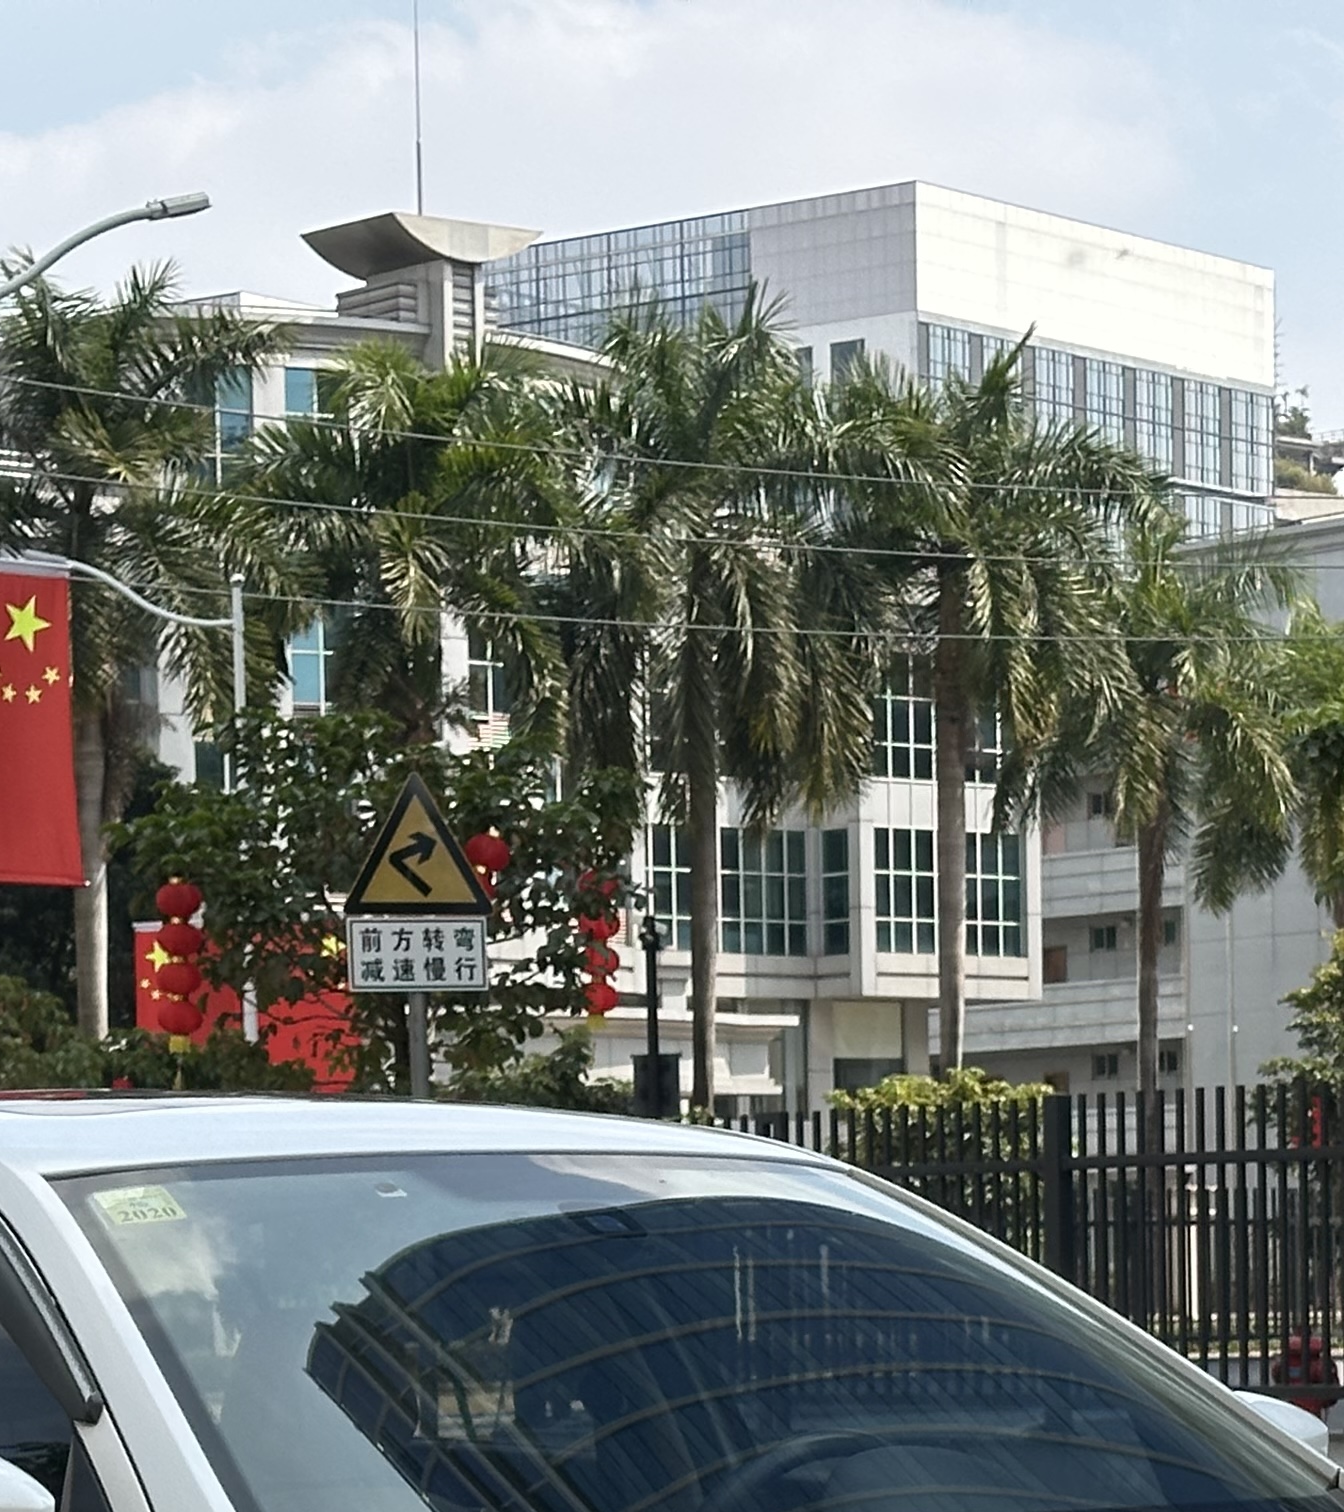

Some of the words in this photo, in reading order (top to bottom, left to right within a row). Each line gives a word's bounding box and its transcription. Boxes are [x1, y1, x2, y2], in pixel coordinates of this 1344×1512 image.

[359, 927, 476, 953] 前方转弯
[360, 957, 477, 982] 减速慢行
